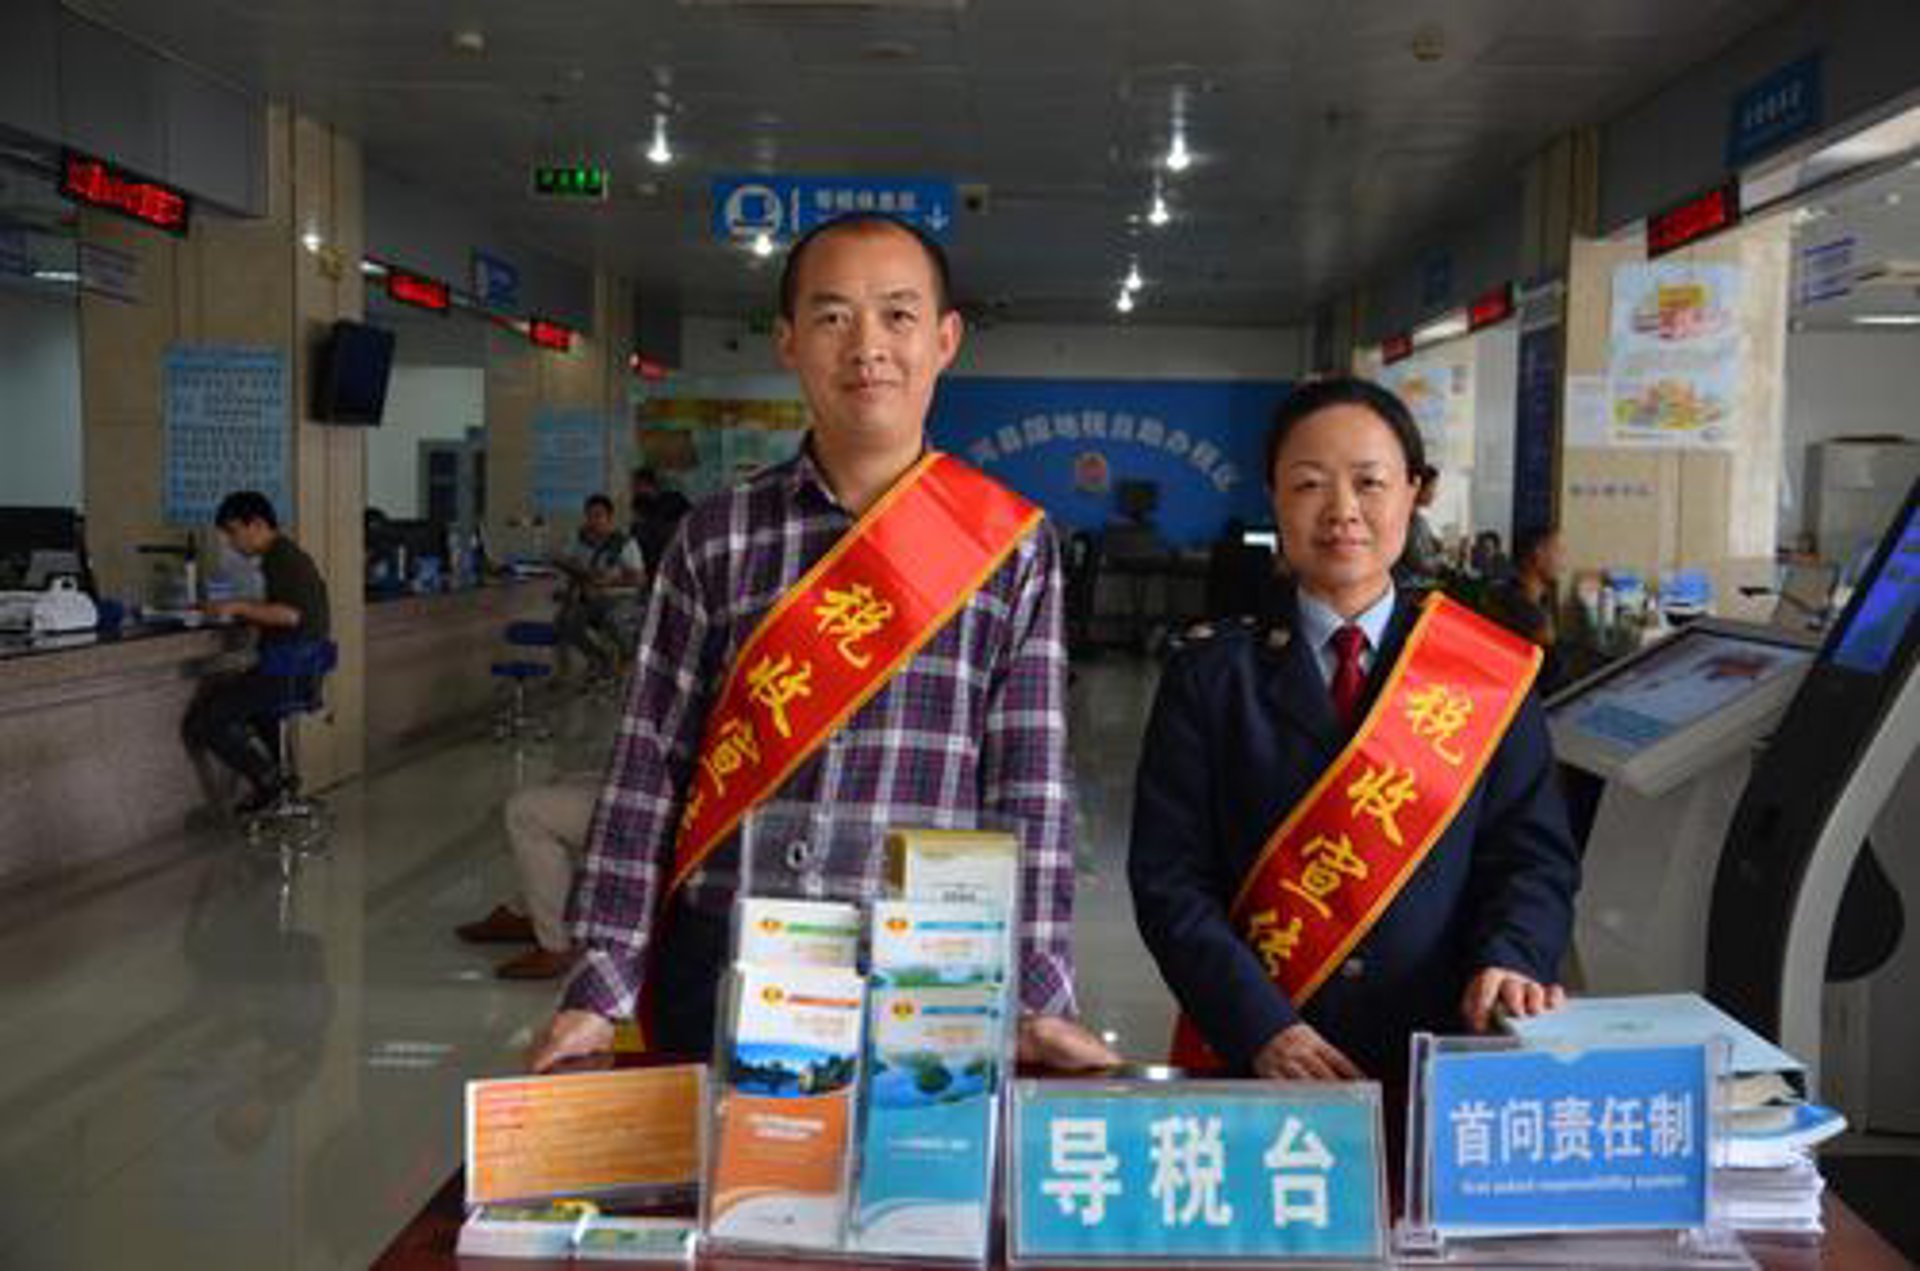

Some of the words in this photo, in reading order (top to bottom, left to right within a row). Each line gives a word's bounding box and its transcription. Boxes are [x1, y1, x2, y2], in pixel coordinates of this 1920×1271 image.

[1041, 1114, 1337, 1228] 导税台
[1450, 1091, 1694, 1168] 首问责任制
